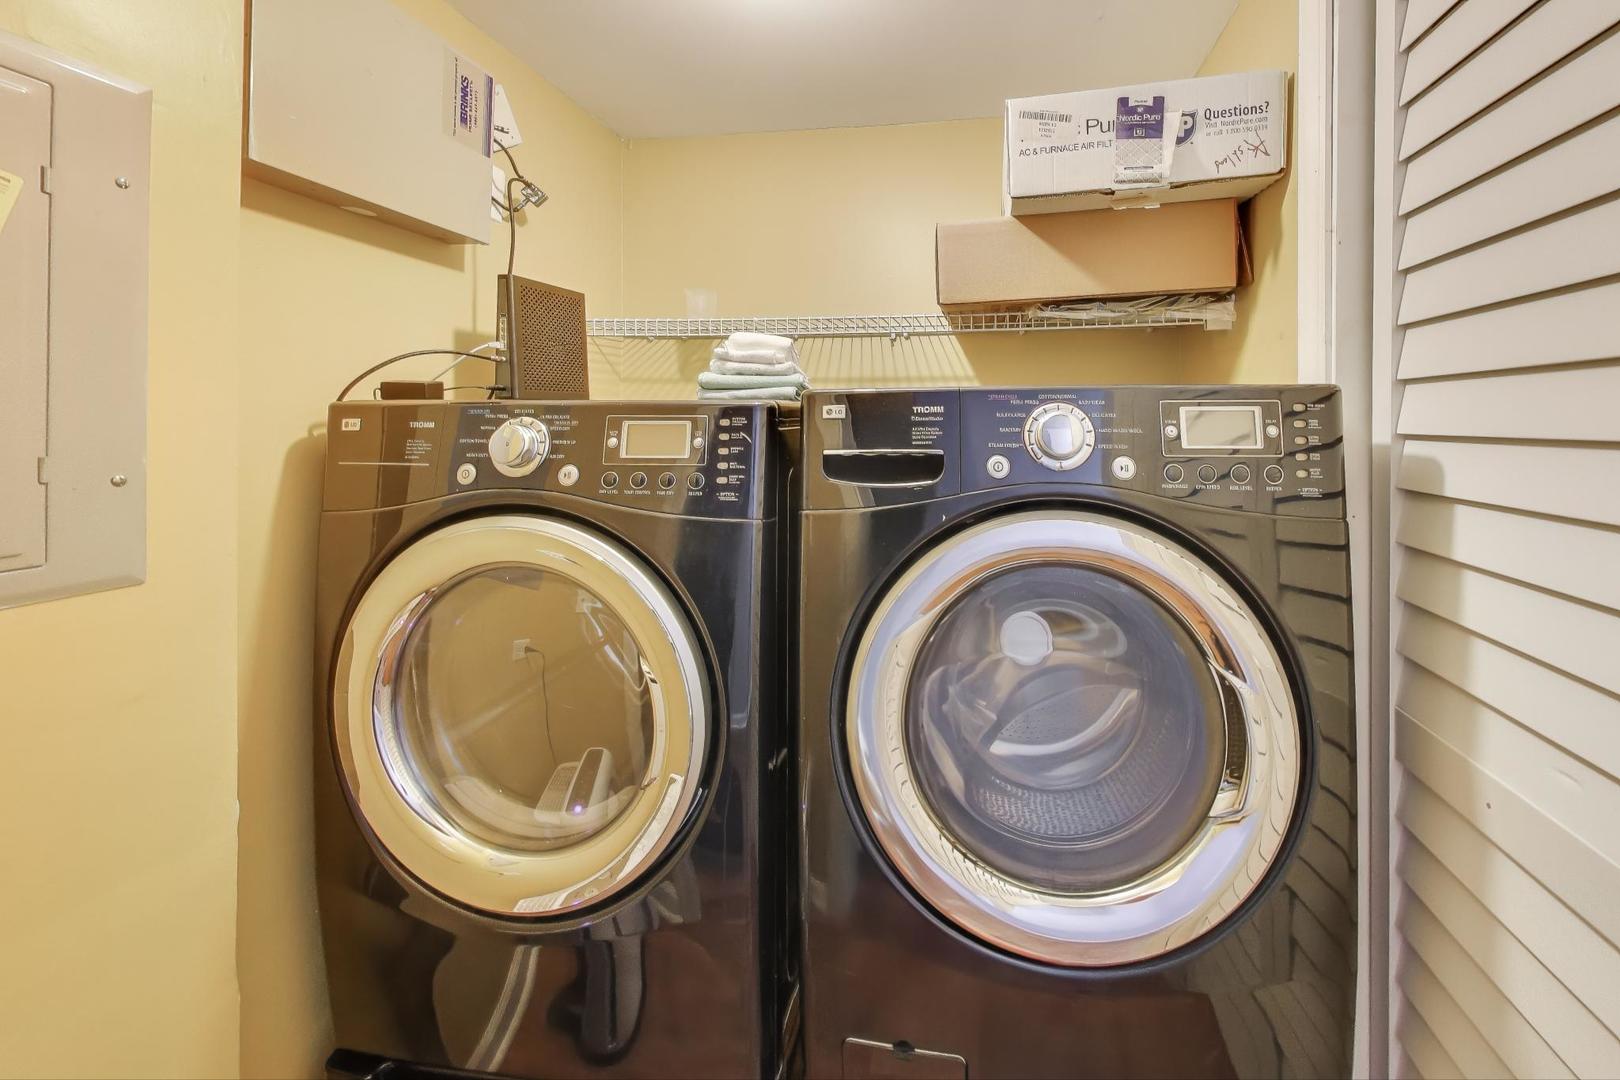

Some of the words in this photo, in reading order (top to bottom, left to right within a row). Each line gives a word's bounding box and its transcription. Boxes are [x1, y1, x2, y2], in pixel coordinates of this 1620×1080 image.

[460, 75, 469, 127] BRINKS
[1204, 101, 1269, 121] Questions?
[1117, 114, 1142, 122] Nordic
[1019, 148, 1031, 157] AC
[1032, 148, 1038, 156] &
[1039, 143, 1079, 155] FURNACE
[1080, 141, 1095, 150] AIR
[912, 406, 945, 414] TROMM
[409, 421, 435, 429] TROMM
